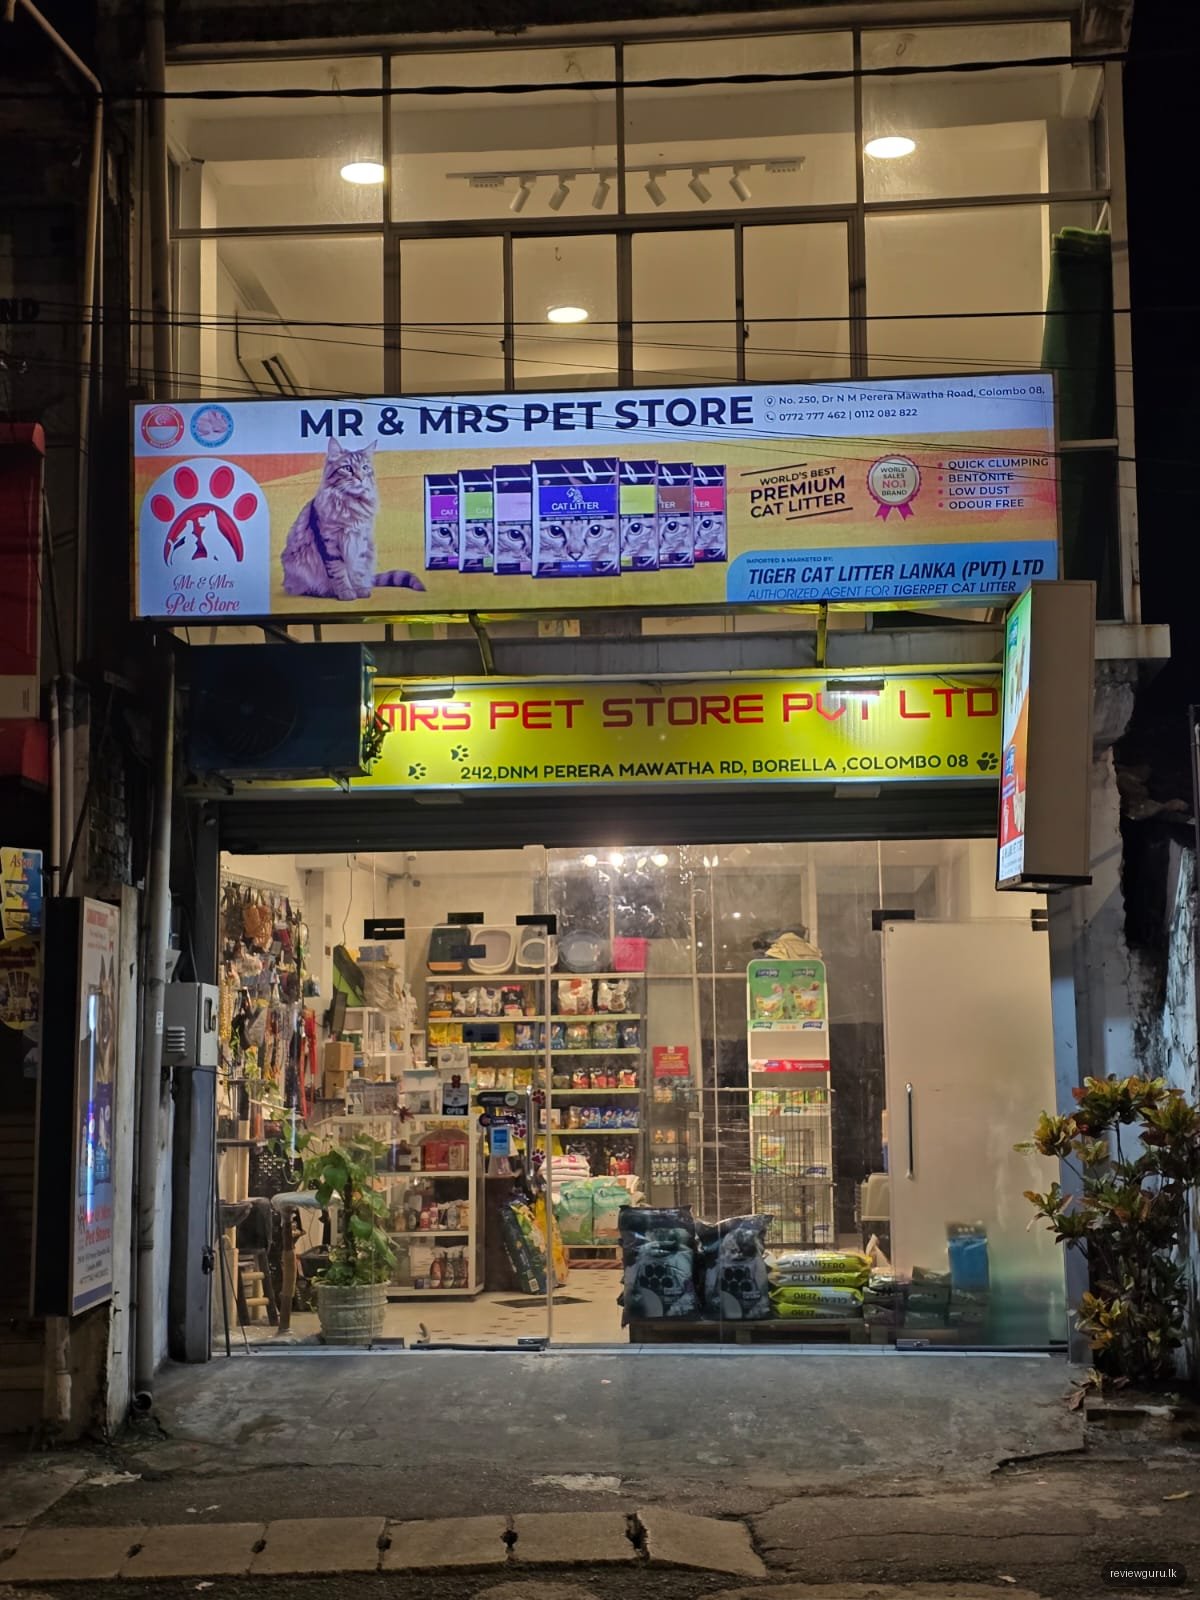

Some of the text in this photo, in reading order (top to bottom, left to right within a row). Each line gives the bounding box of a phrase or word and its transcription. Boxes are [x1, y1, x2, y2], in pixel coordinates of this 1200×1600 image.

[779, 396, 797, 405] No.
[799, 395, 819, 405] 250,
[822, 395, 833, 403] Dr
[837, 394, 844, 403] N
[848, 394, 857, 402] M
[860, 393, 893, 402] Perera
[896, 390, 944, 400] Mawatha
[947, 389, 976, 399] Road,
[978, 386, 1026, 397] Colombo
[301, 396, 754, 437] MR & MRS PET STORE
[779, 412, 804, 422] 0772
[806, 412, 825, 421] 777
[827, 411, 846, 420] 462
[854, 410, 875, 419] 0112
[878, 409, 897, 418] 082
[899, 408, 917, 417] 822
[948, 458, 1049, 470] QUICK CLUMPING
[760, 466, 837, 486] WORLD'S BEST
[882, 480, 906, 489] NO.1
[948, 472, 1015, 483] BENTONITE
[750, 475, 846, 503] PREMIUM
[949, 486, 1010, 496] LOW DUST
[551, 501, 600, 511] CAT LITTER
[750, 492, 846, 519] CAT LITTER
[949, 498, 1025, 510] ODOUR FREE
[749, 559, 1044, 585] TIGER CAT LITTER LANKA (PVT) LTD
[173, 575, 195, 591] Mr
[209, 574, 234, 590] Mrs
[747, 581, 1016, 600] AUTHORIZED AGENT FOR TIGERPET CAT LITTER
[166, 591, 241, 615] Pet Store
[375, 687, 999, 732] MRS PET STORE PVT LTD
[544, 763, 613, 779] PERERA
[619, 761, 714, 777] MAWATHA
[720, 761, 747, 776] RD,
[753, 758, 837, 773] BORELLA
[947, 754, 969, 768] 08
